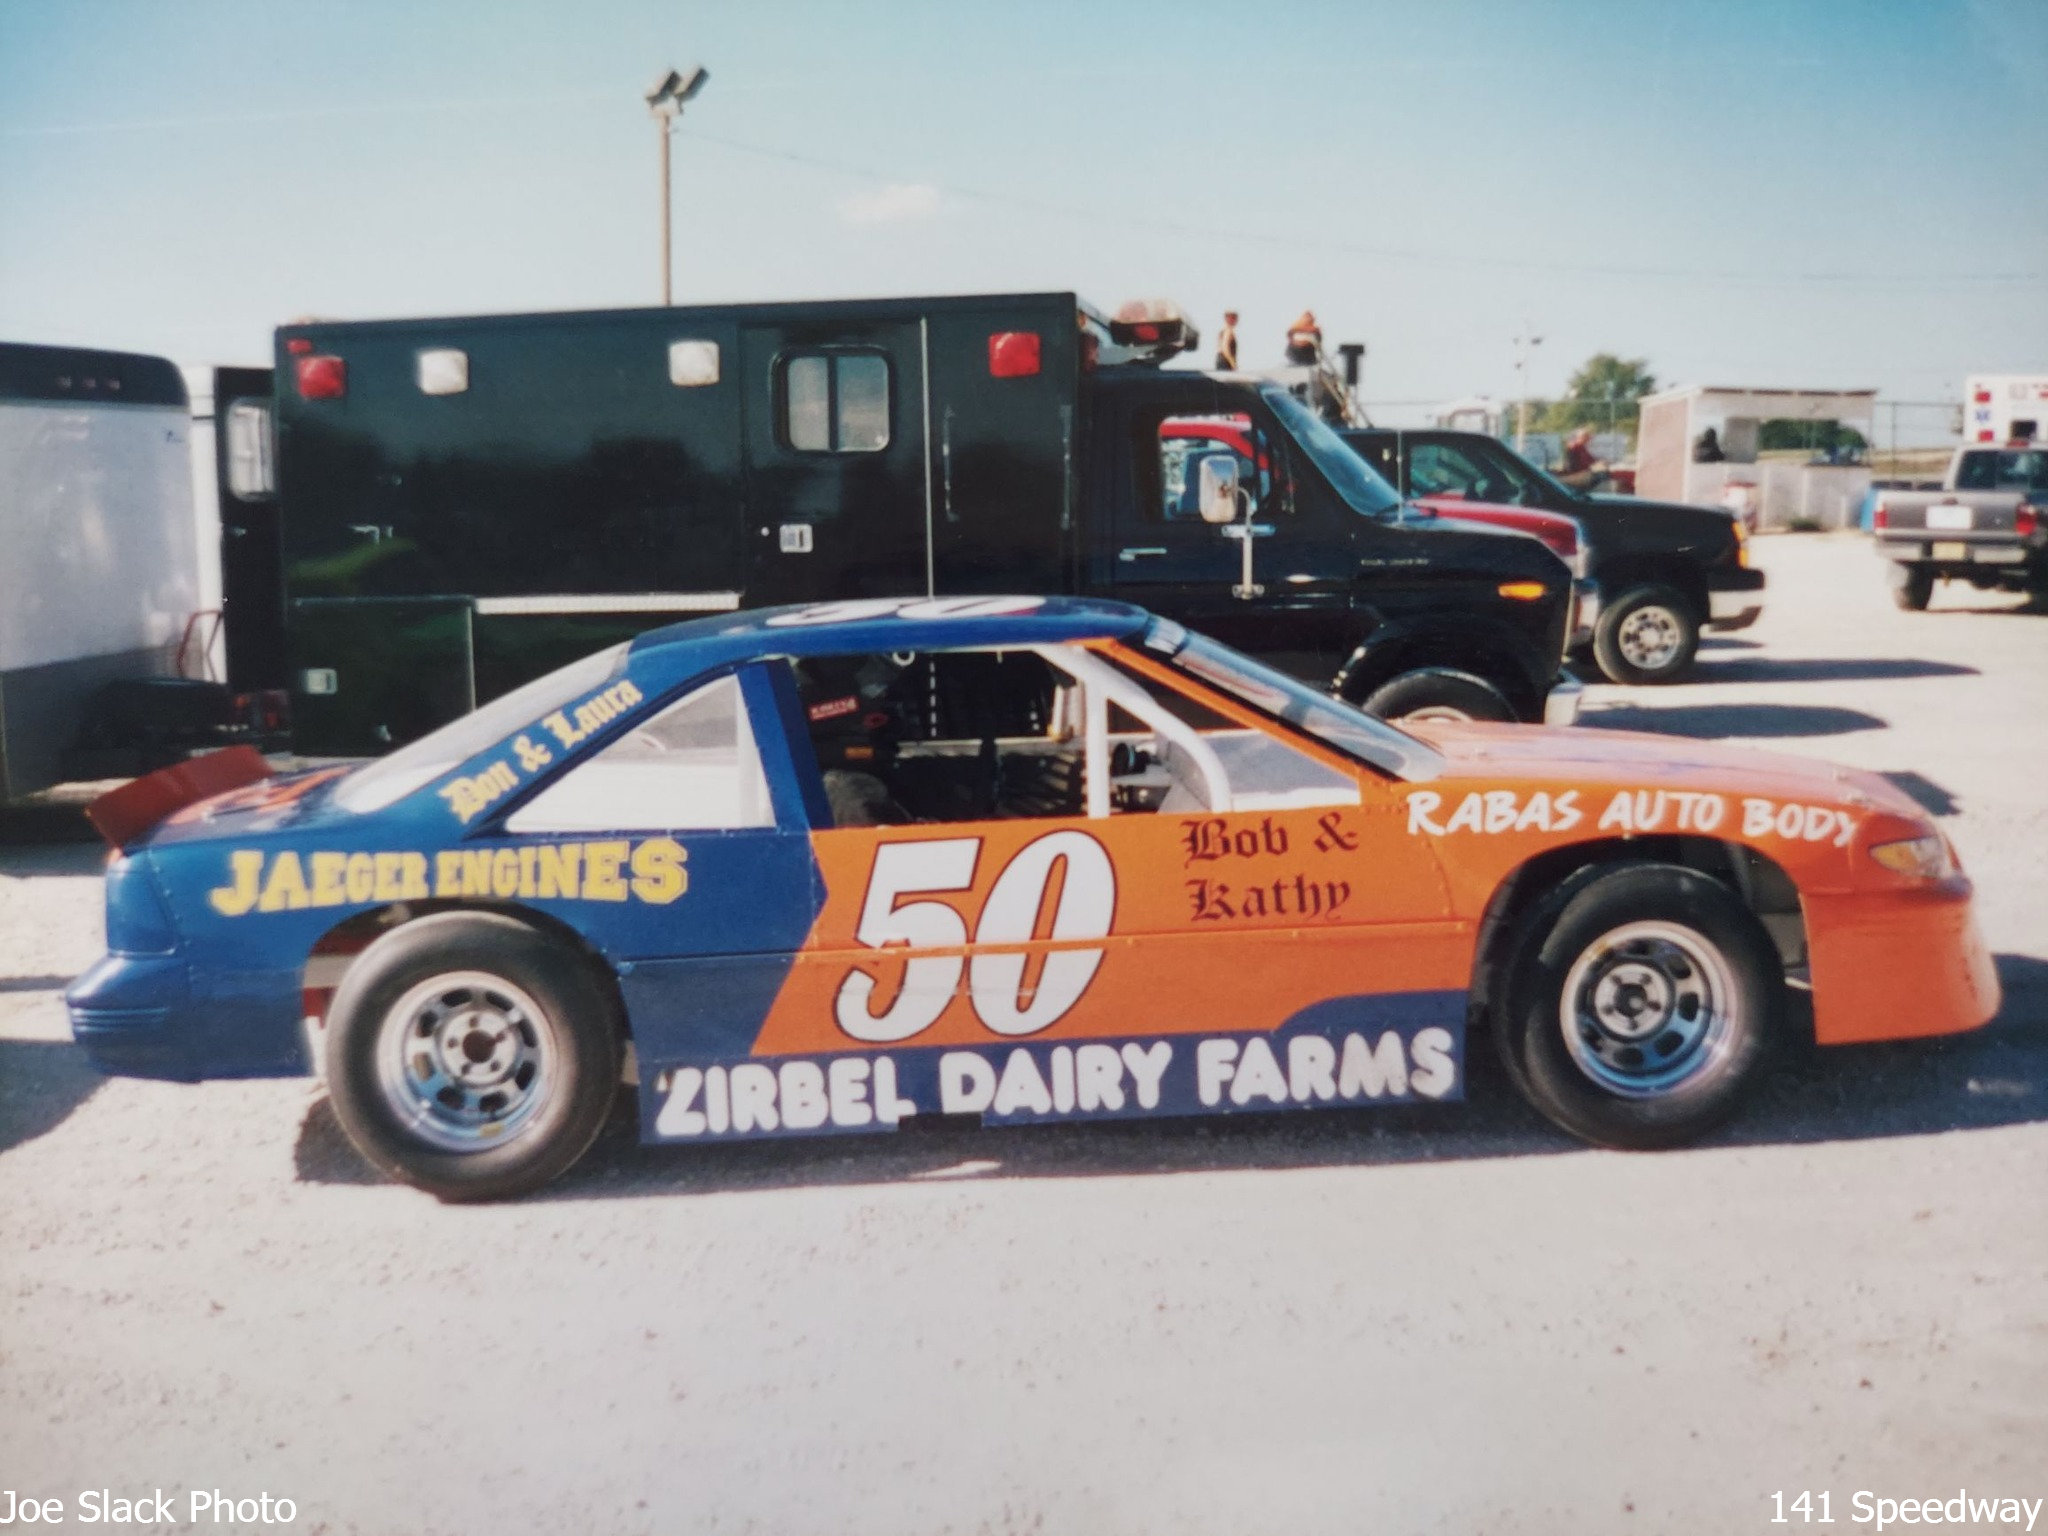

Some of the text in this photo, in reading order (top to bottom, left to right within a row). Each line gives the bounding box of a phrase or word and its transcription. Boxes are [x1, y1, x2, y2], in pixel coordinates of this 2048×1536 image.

[438, 680, 643, 824] Don & Laura
[1180, 811, 1360, 869] Bob &
[1406, 788, 1859, 847] RABAS AUTO BODY
[208, 837, 689, 916] JAEGER ENGINES
[1185, 872, 1351, 921] Kathy
[832, 828, 1118, 1044] 50
[655, 1027, 1455, 1136] ZIRBEL DAIRY FARMS
